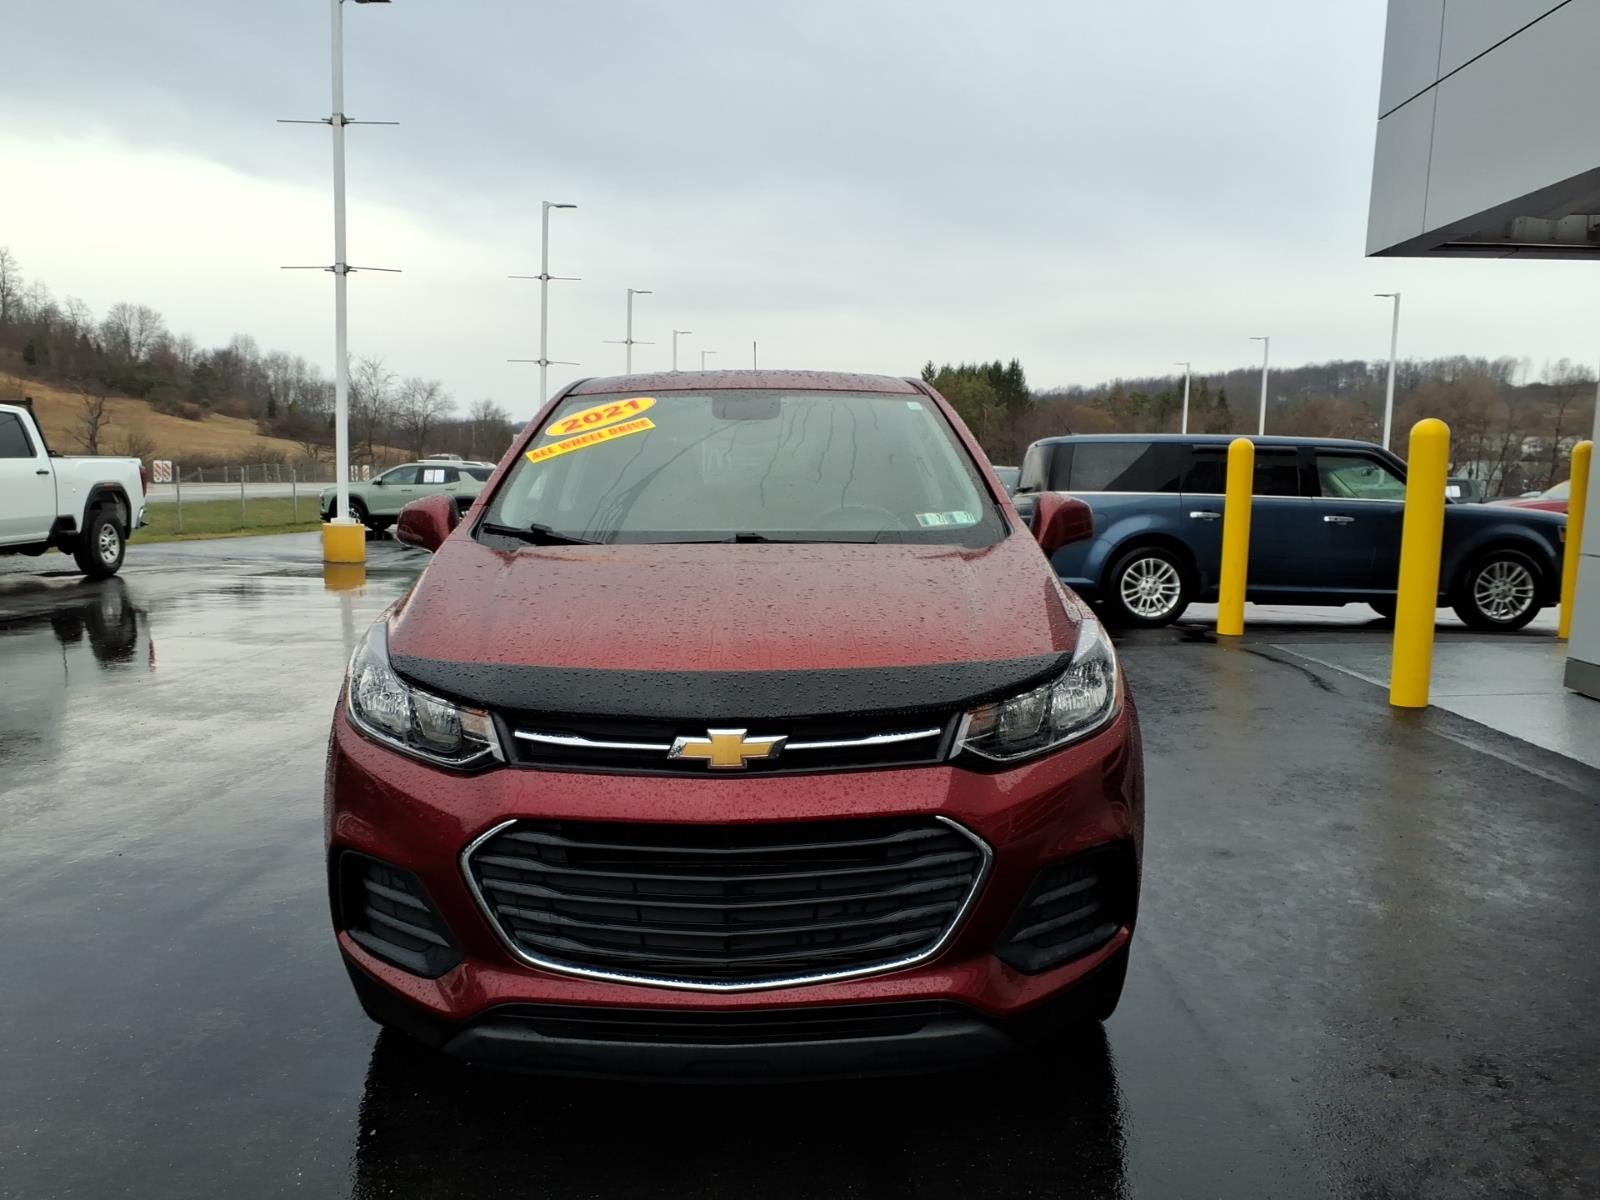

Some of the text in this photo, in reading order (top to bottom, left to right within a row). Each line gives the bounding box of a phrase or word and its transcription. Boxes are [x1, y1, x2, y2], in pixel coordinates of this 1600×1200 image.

[561, 400, 640, 433] 2021
[531, 419, 650, 461] ALL WHEEL DRIVE
